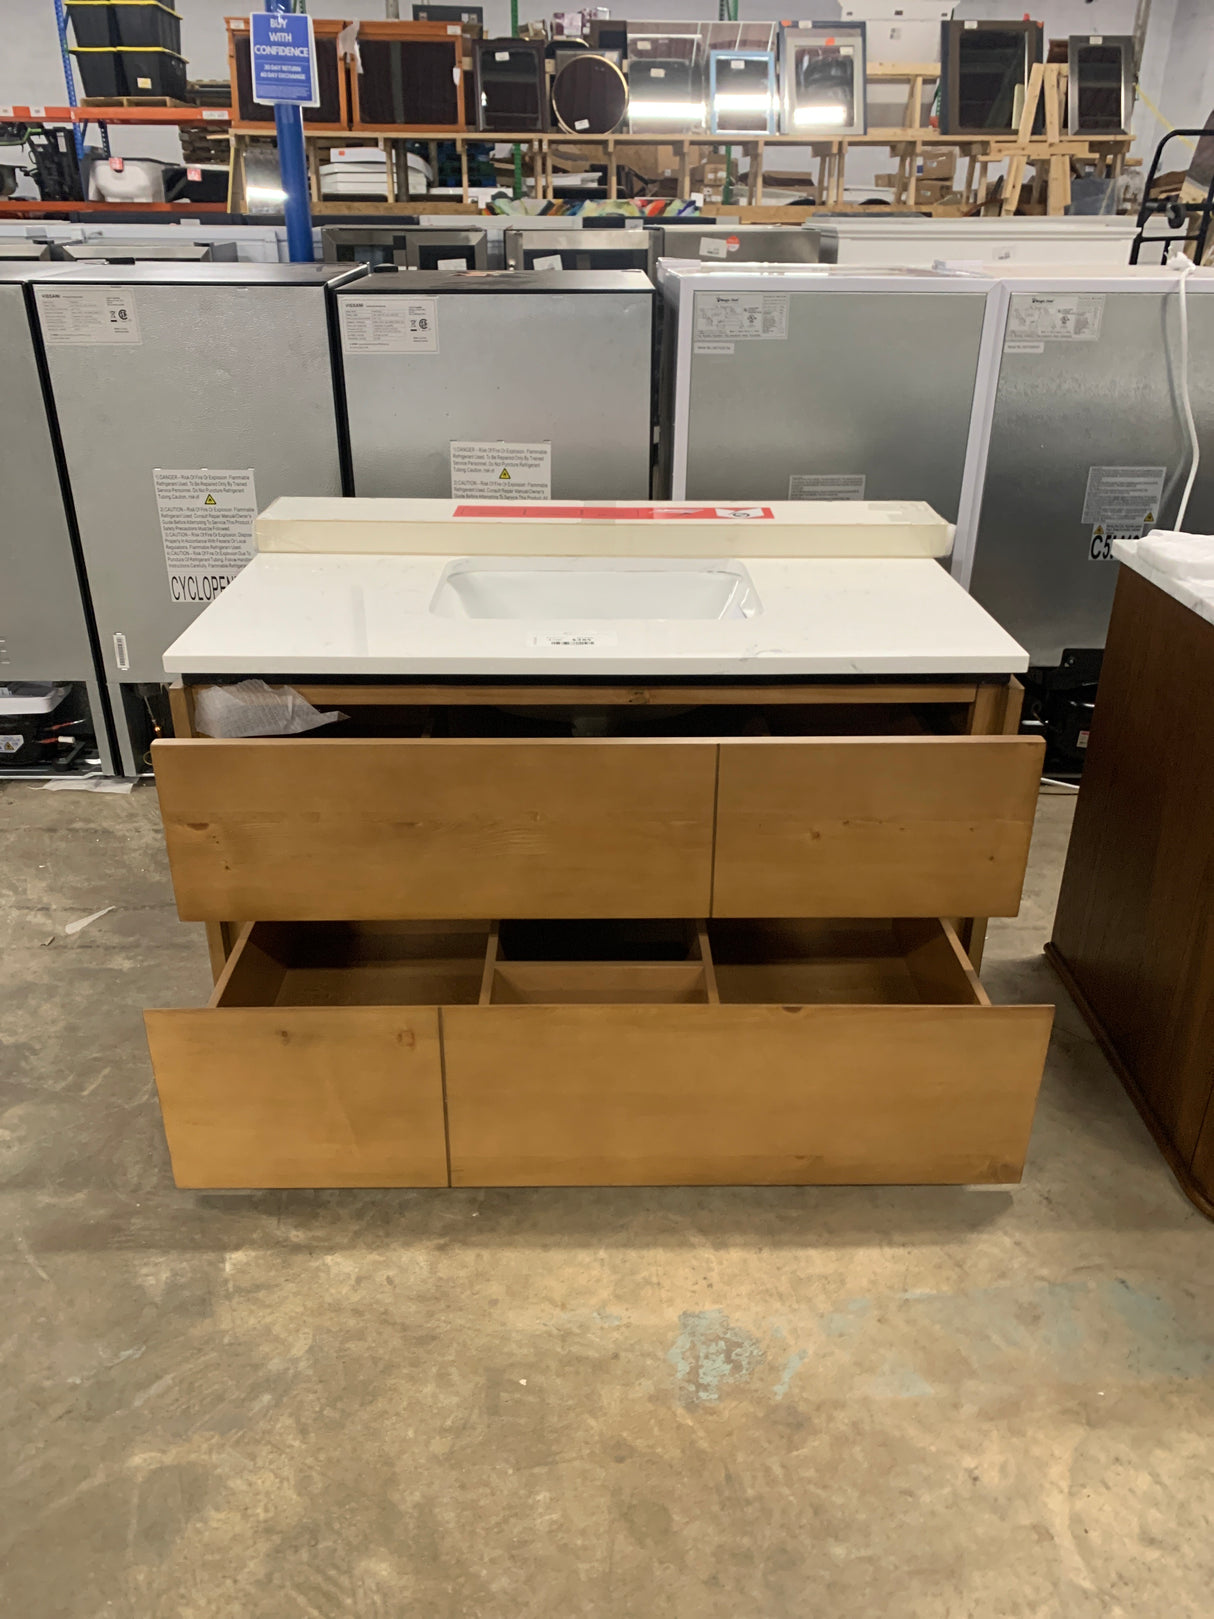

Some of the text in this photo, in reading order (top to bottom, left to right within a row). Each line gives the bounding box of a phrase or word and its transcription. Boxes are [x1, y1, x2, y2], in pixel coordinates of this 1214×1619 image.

[270, 18, 288, 28] BUY
[268, 32, 292, 42] WITH
[254, 45, 309, 57] CONFIDENCE
[171, 576, 236, 601] CYCLOPE
